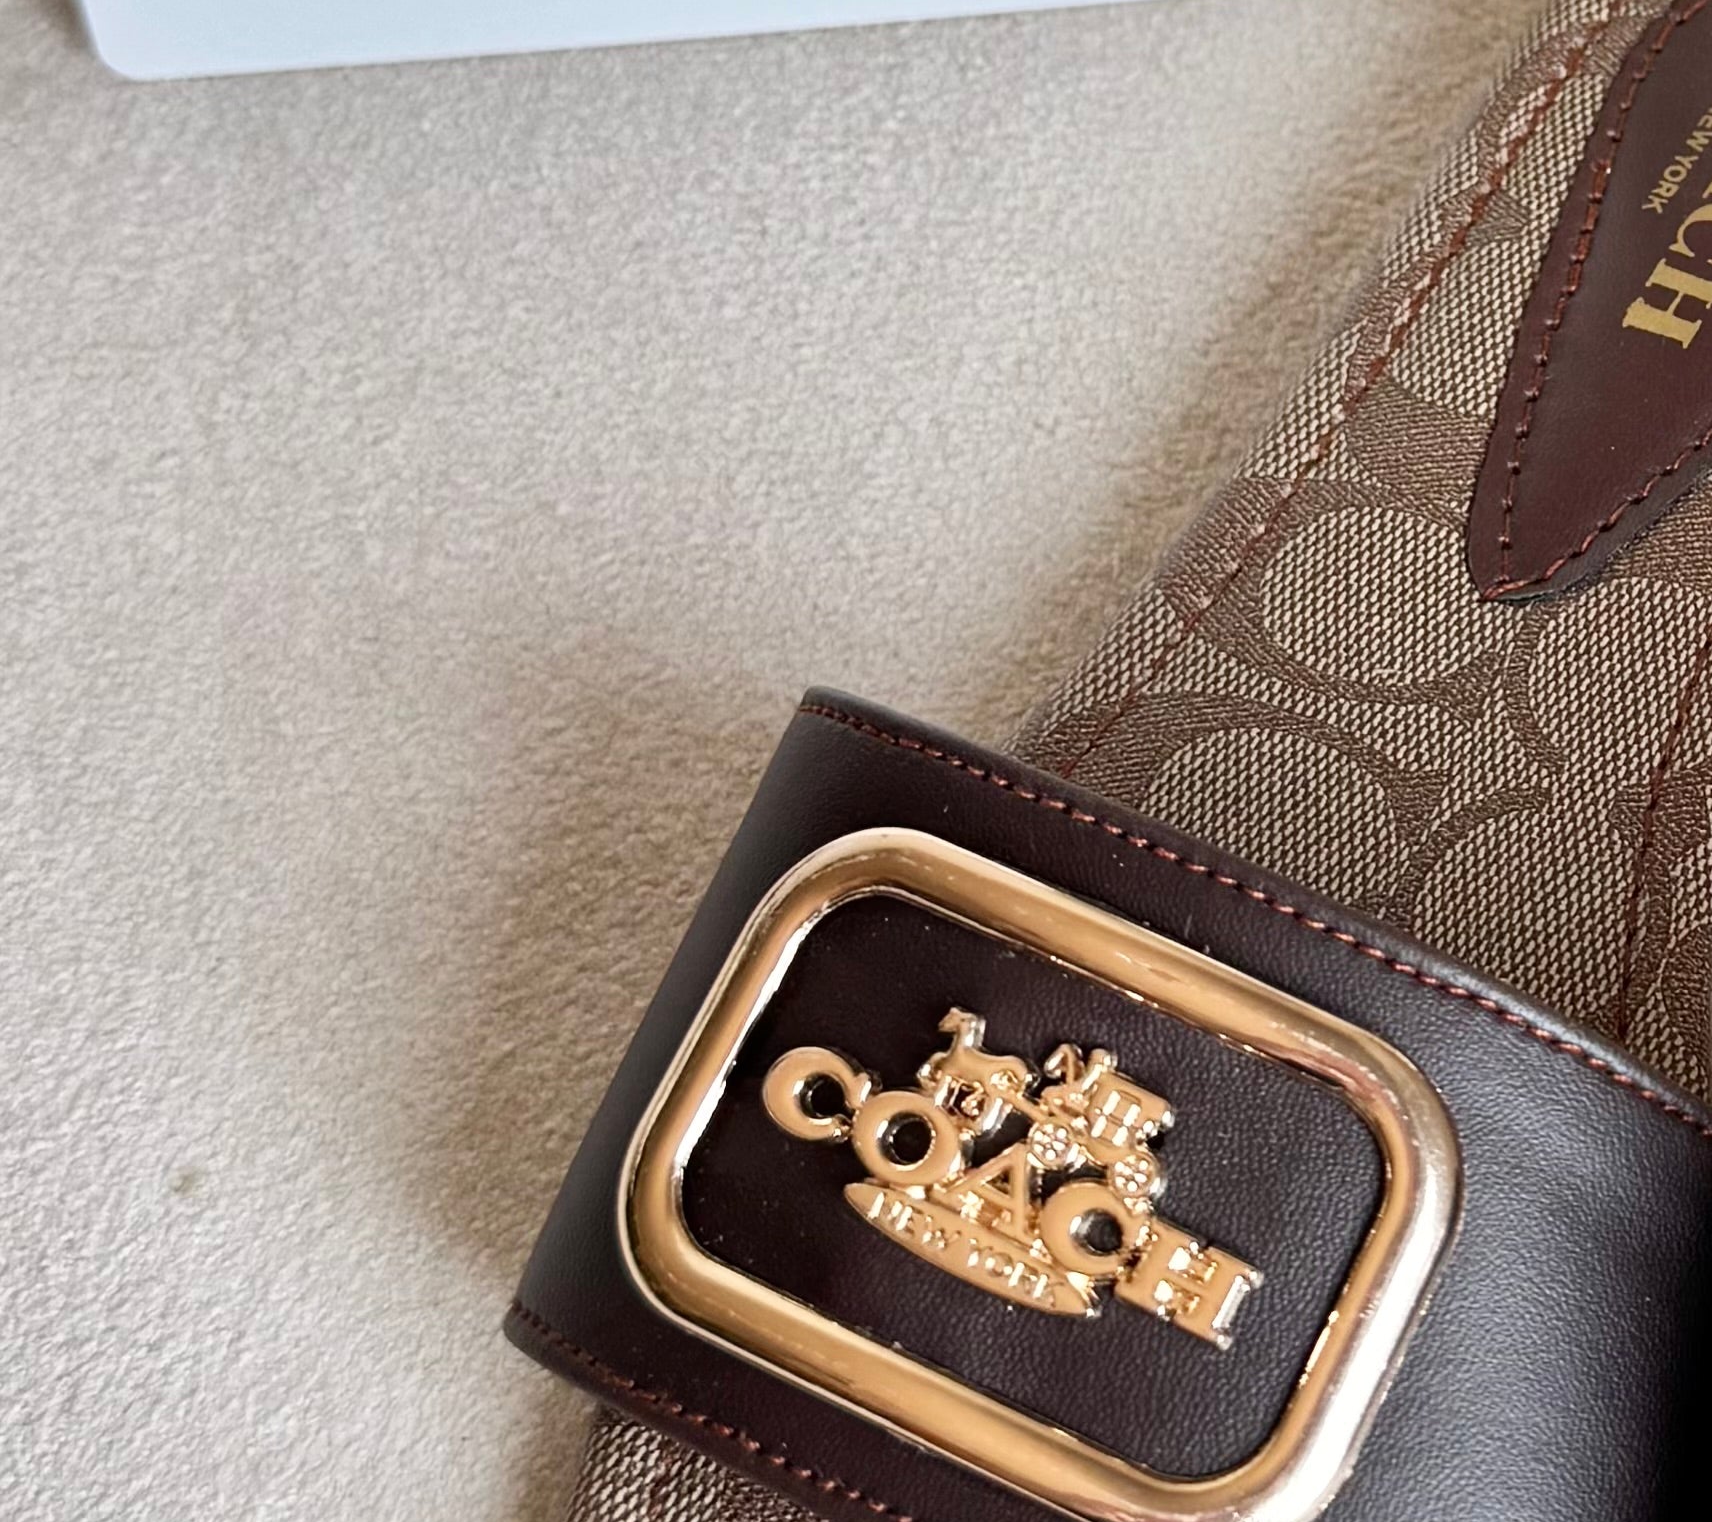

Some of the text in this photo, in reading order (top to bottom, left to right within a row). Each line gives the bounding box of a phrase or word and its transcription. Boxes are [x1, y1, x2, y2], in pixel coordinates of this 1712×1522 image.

[1641, 155, 1699, 214] YORK
[762, 1046, 1263, 1350] COACH
[866, 1190, 962, 1252] NEW
